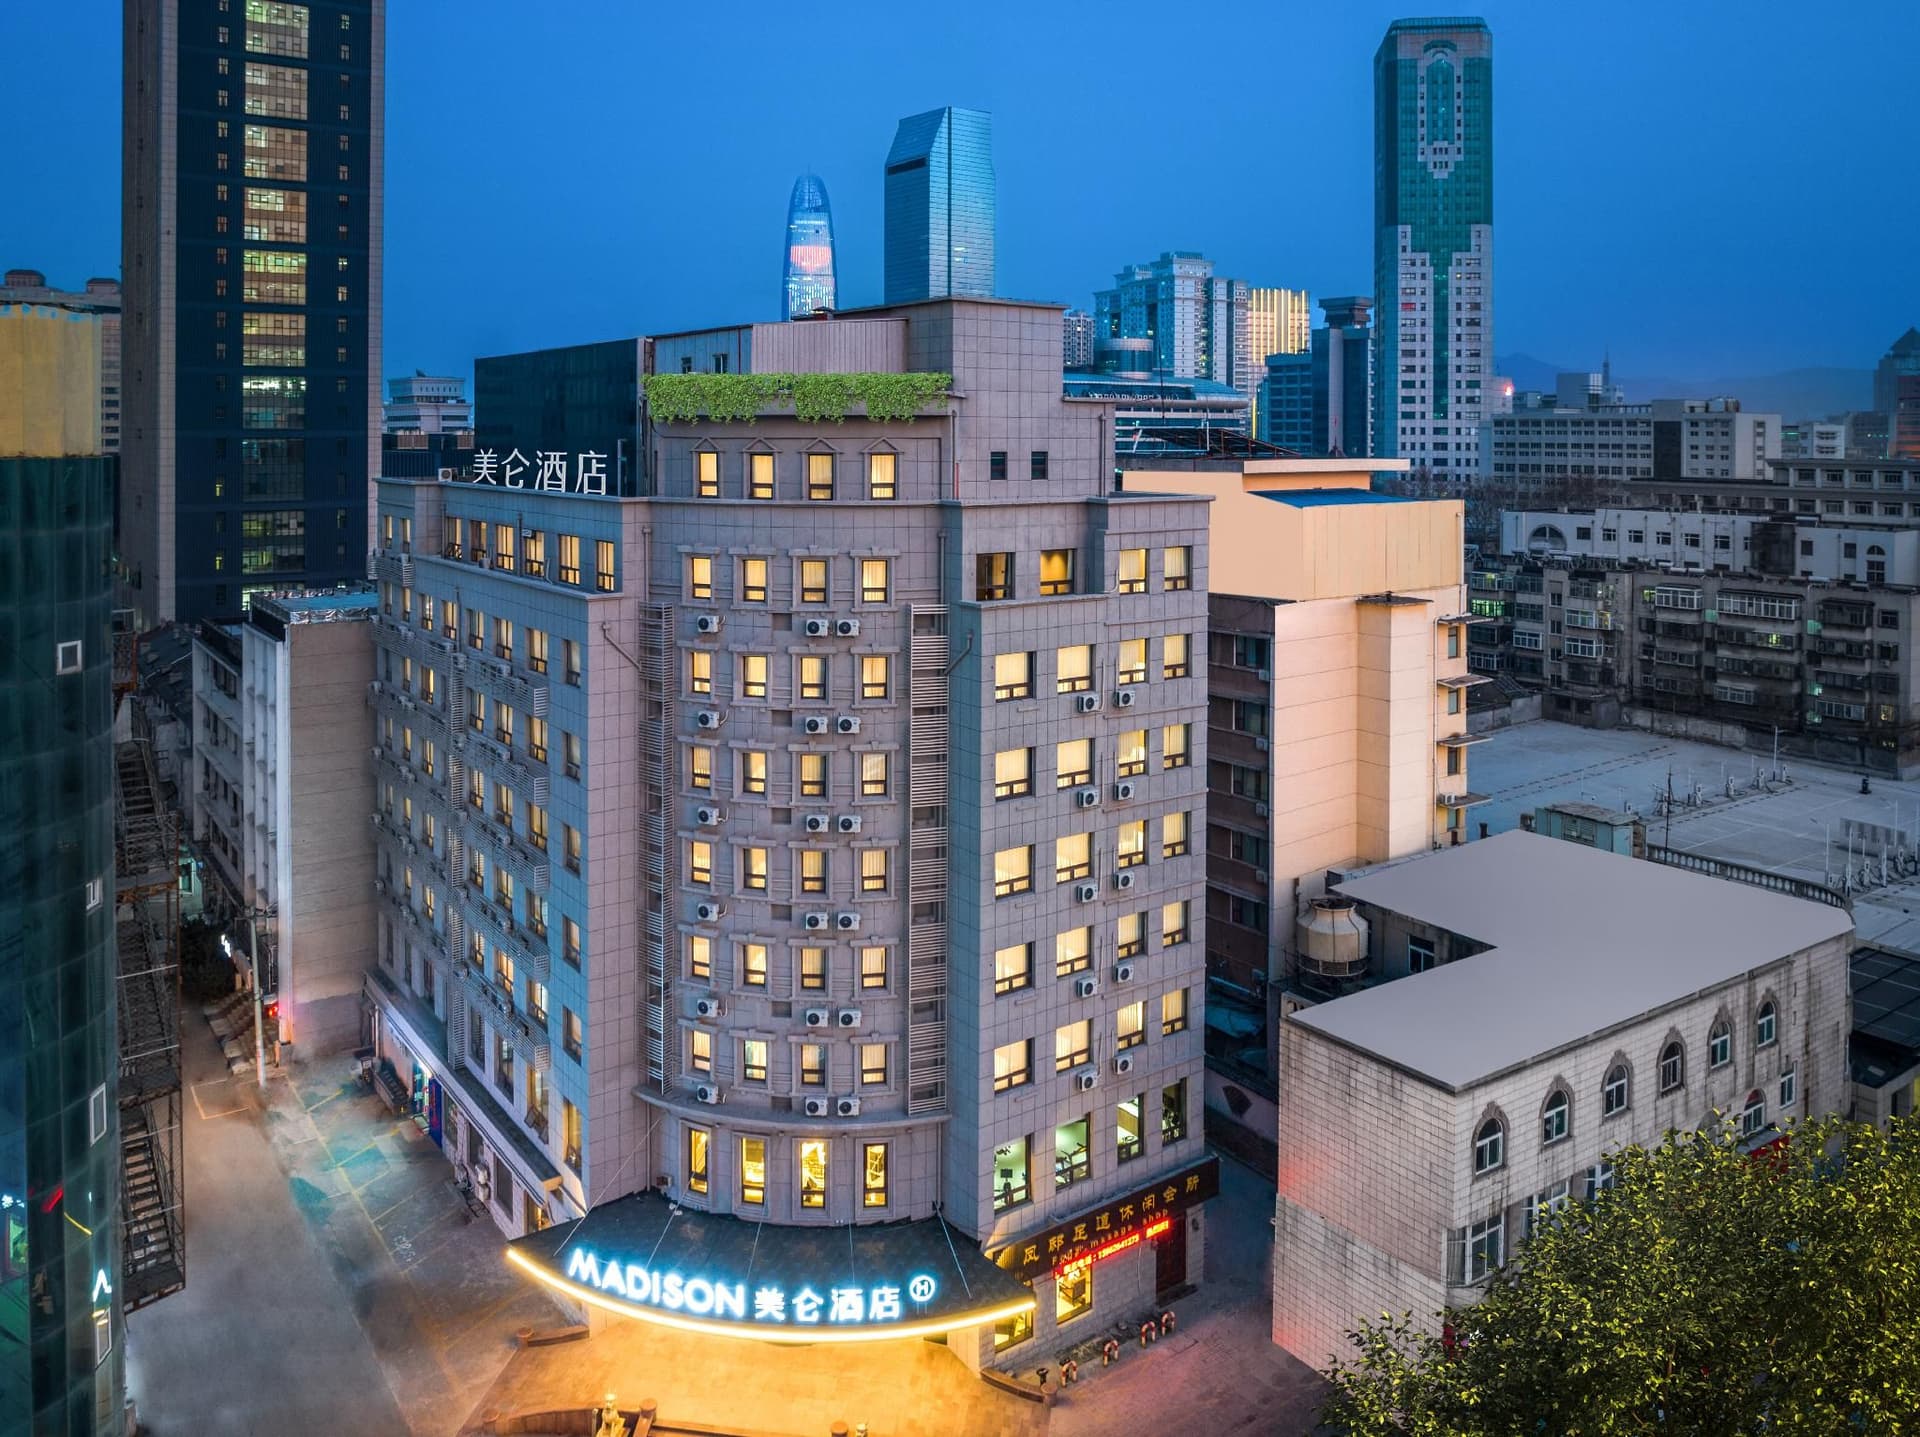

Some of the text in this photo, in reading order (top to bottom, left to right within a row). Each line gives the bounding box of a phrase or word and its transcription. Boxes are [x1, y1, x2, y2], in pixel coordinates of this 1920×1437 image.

[472, 448, 608, 496] 美仑酒店
[567, 1247, 746, 1318] MADISON
[754, 1286, 901, 1322] 美仑酒店
